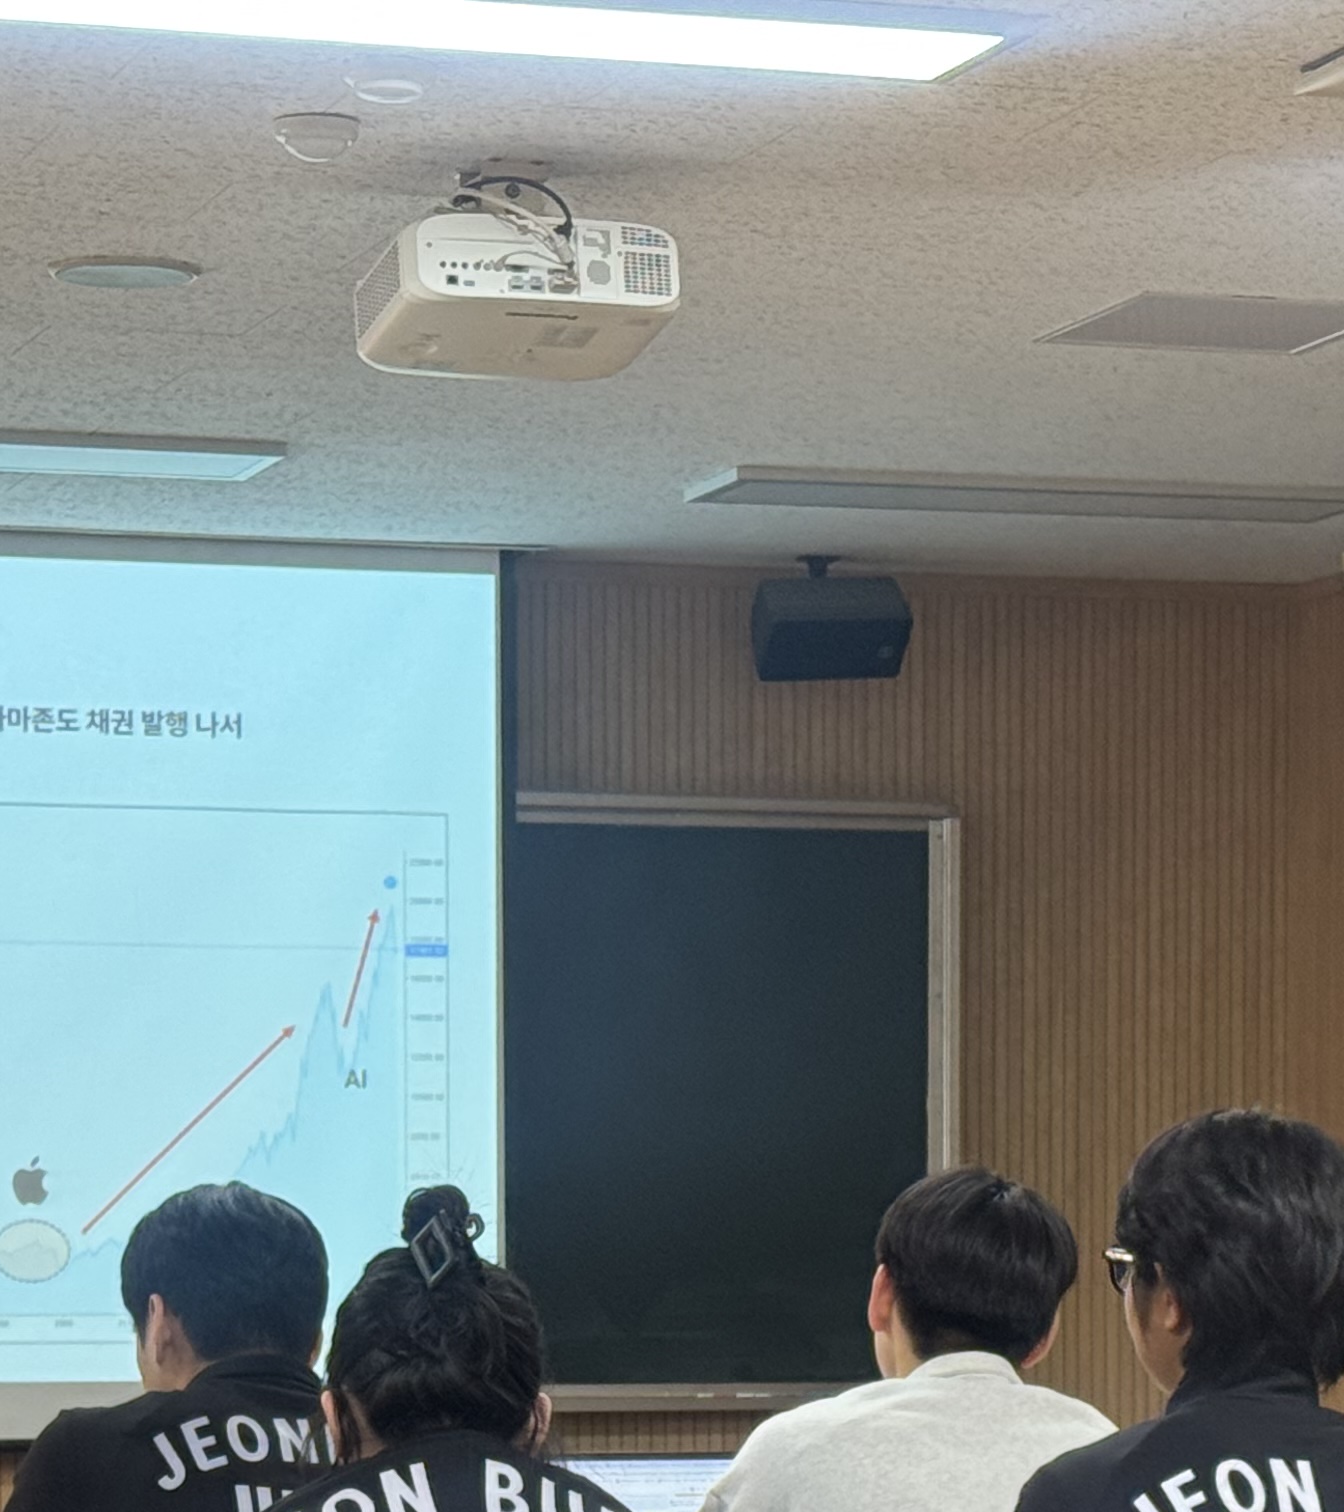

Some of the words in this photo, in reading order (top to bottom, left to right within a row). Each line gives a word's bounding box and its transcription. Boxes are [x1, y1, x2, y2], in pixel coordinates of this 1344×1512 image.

[85, 708, 134, 736] 채권
[141, 710, 188, 738] 발행
[195, 711, 243, 740] 나서
[344, 1068, 367, 1090] AI
[153, 1414, 320, 1491] JEON
